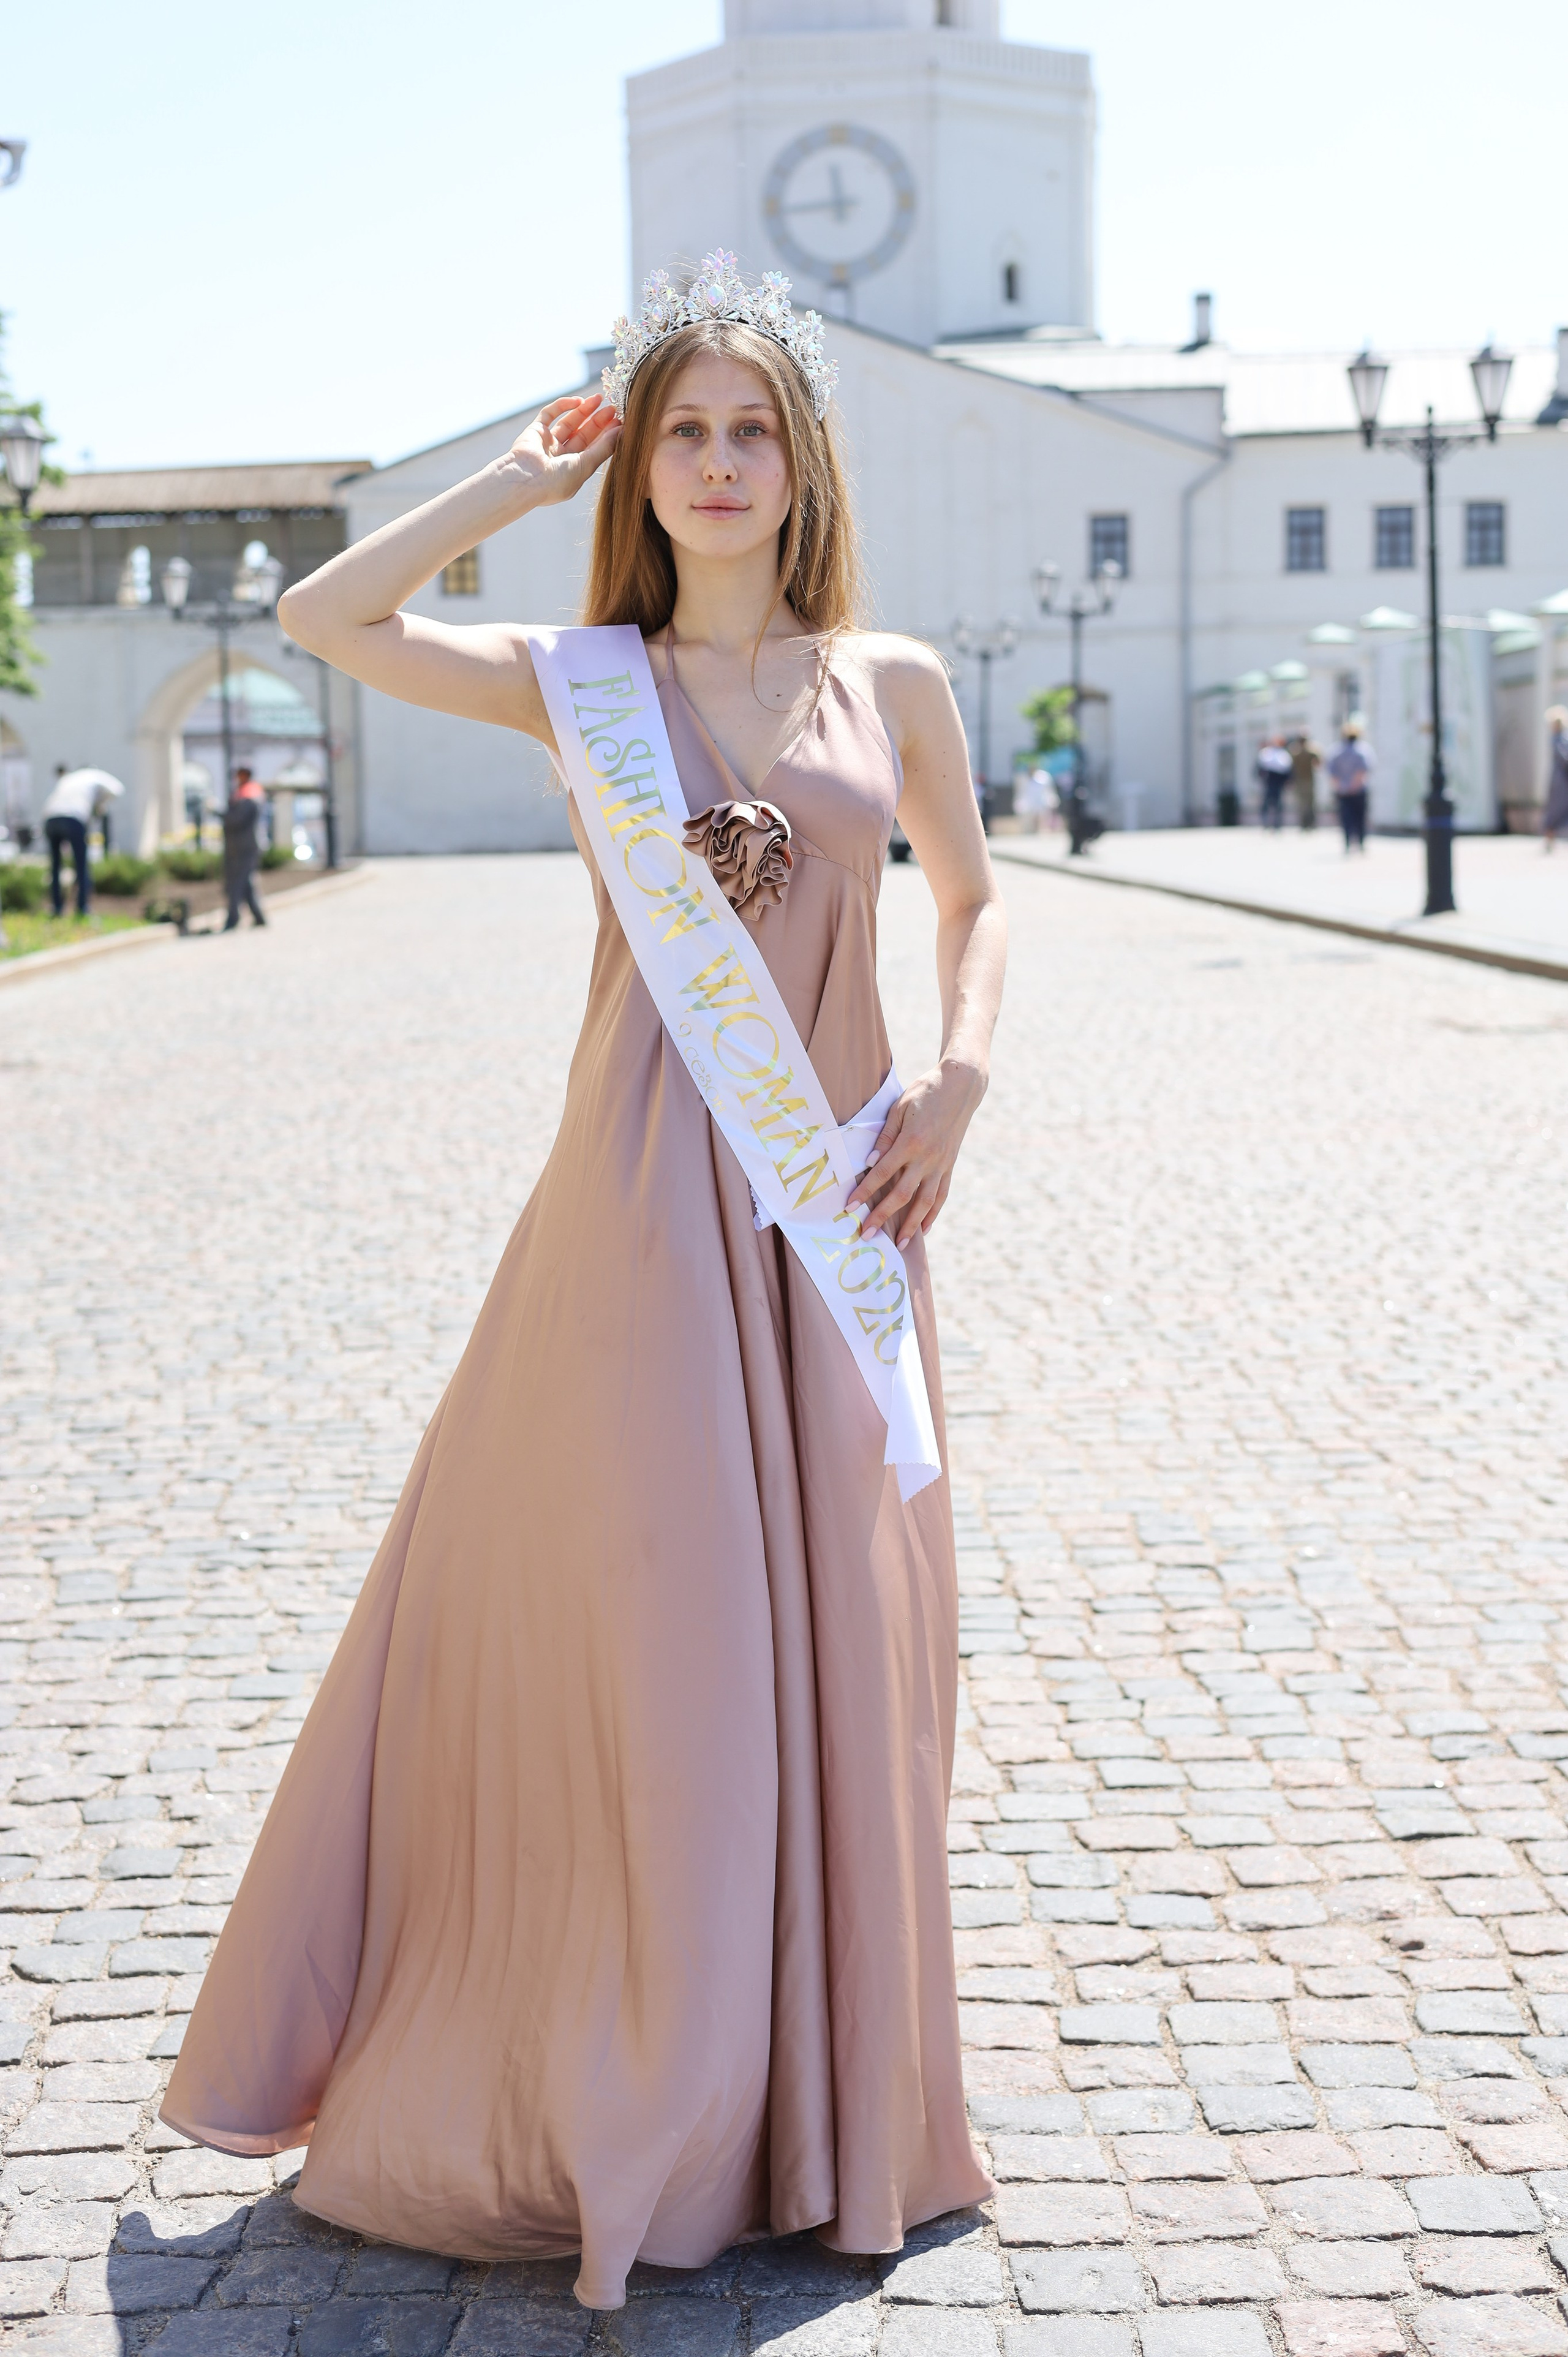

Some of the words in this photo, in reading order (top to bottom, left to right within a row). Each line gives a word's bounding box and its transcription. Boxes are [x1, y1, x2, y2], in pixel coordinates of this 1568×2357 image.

[568, 669, 721, 945] FASHION
[678, 942, 840, 1210] WOMAN
[673, 1022, 692, 1038] 9
